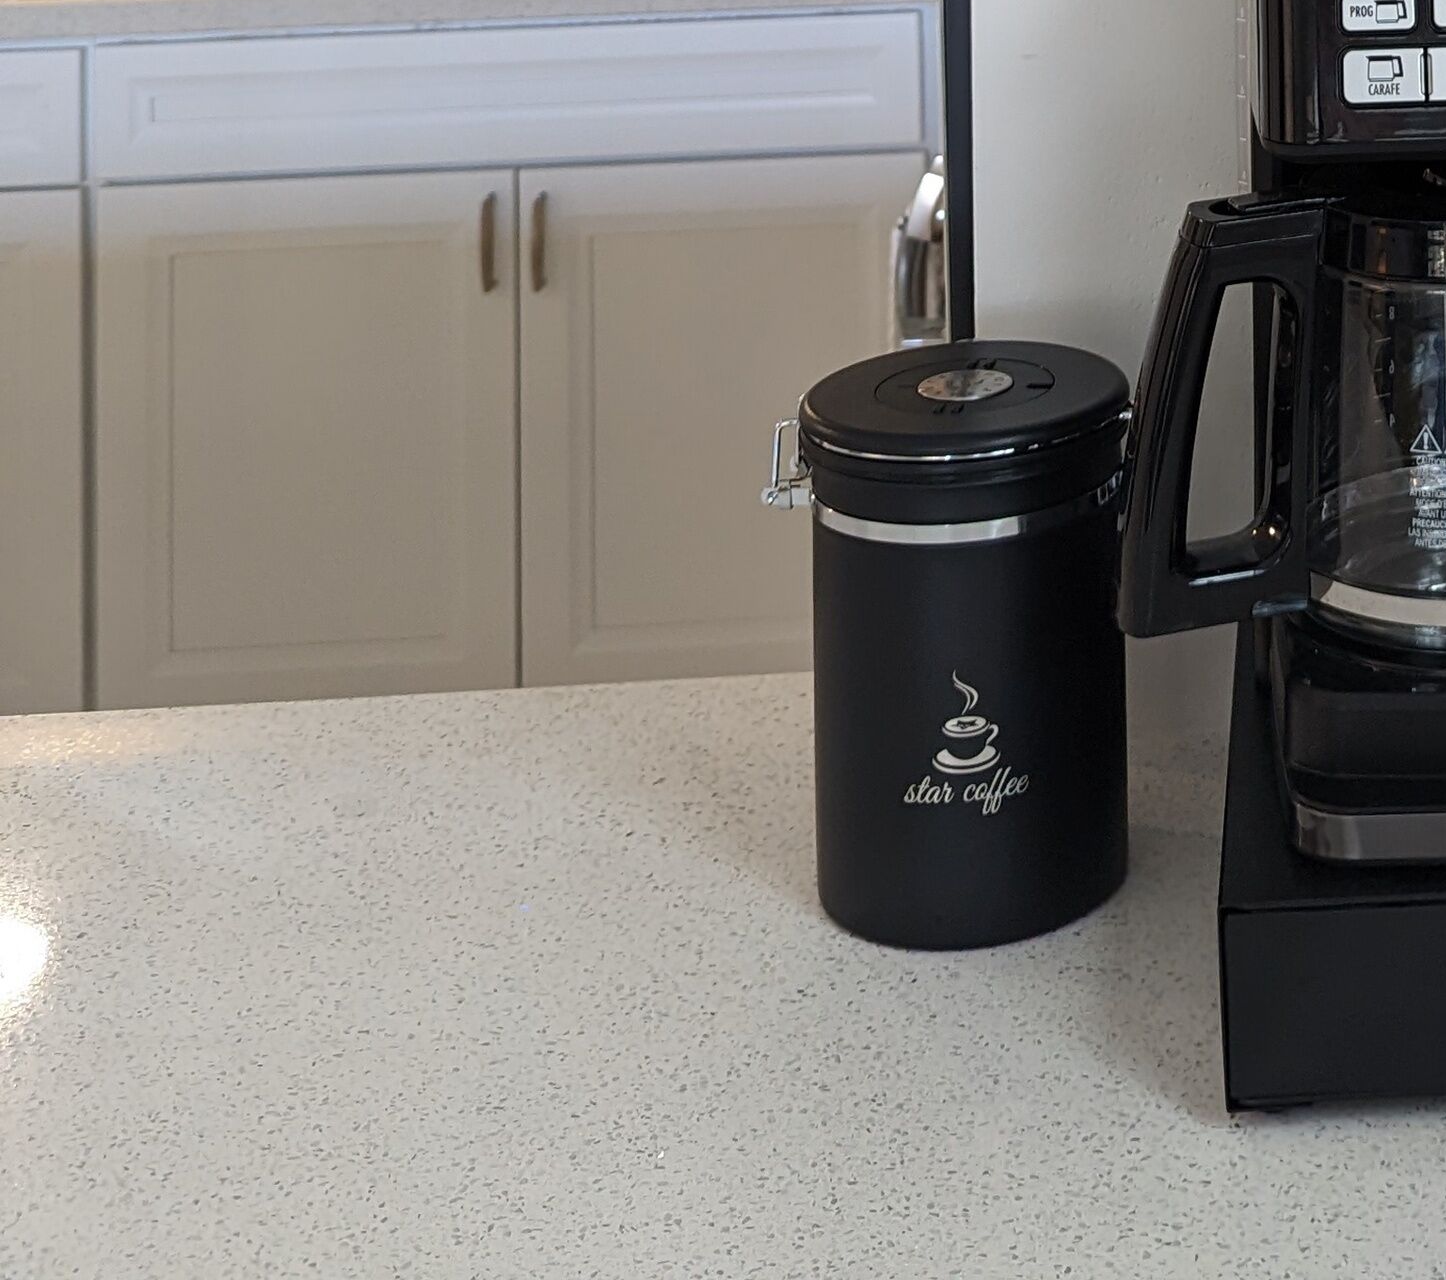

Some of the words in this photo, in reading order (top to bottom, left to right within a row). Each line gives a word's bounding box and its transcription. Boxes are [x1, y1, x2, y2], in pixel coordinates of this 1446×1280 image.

[1349, 5, 1374, 18] PROG
[1368, 82, 1400, 96] CARAFE
[903, 775, 955, 804] star
[963, 766, 1030, 816] coffee
